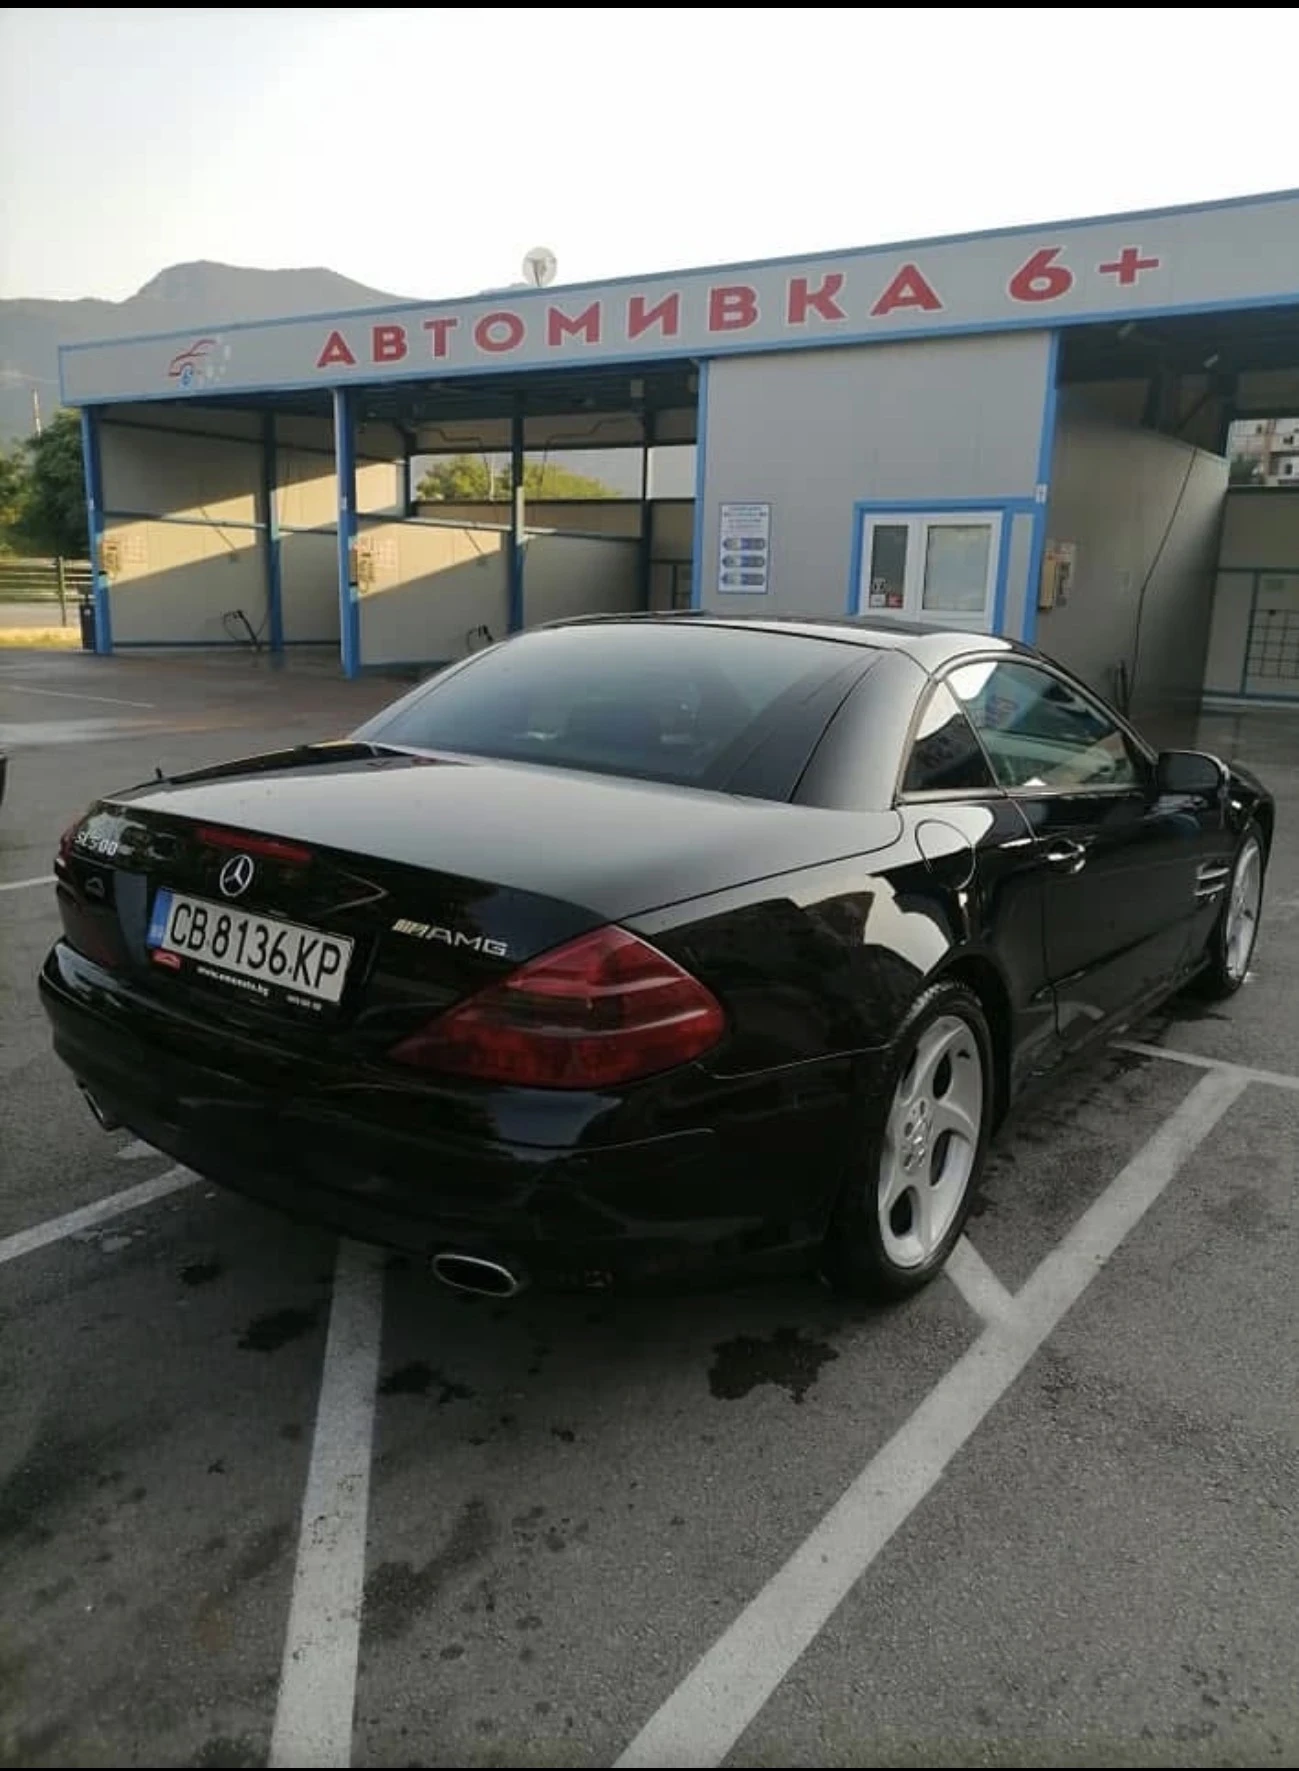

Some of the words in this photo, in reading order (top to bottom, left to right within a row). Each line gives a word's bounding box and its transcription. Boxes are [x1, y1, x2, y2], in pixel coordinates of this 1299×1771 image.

[315, 262, 943, 369] АВТОМИВКА
[1006, 244, 1161, 303] 6+
[425, 926, 508, 957] AMG
